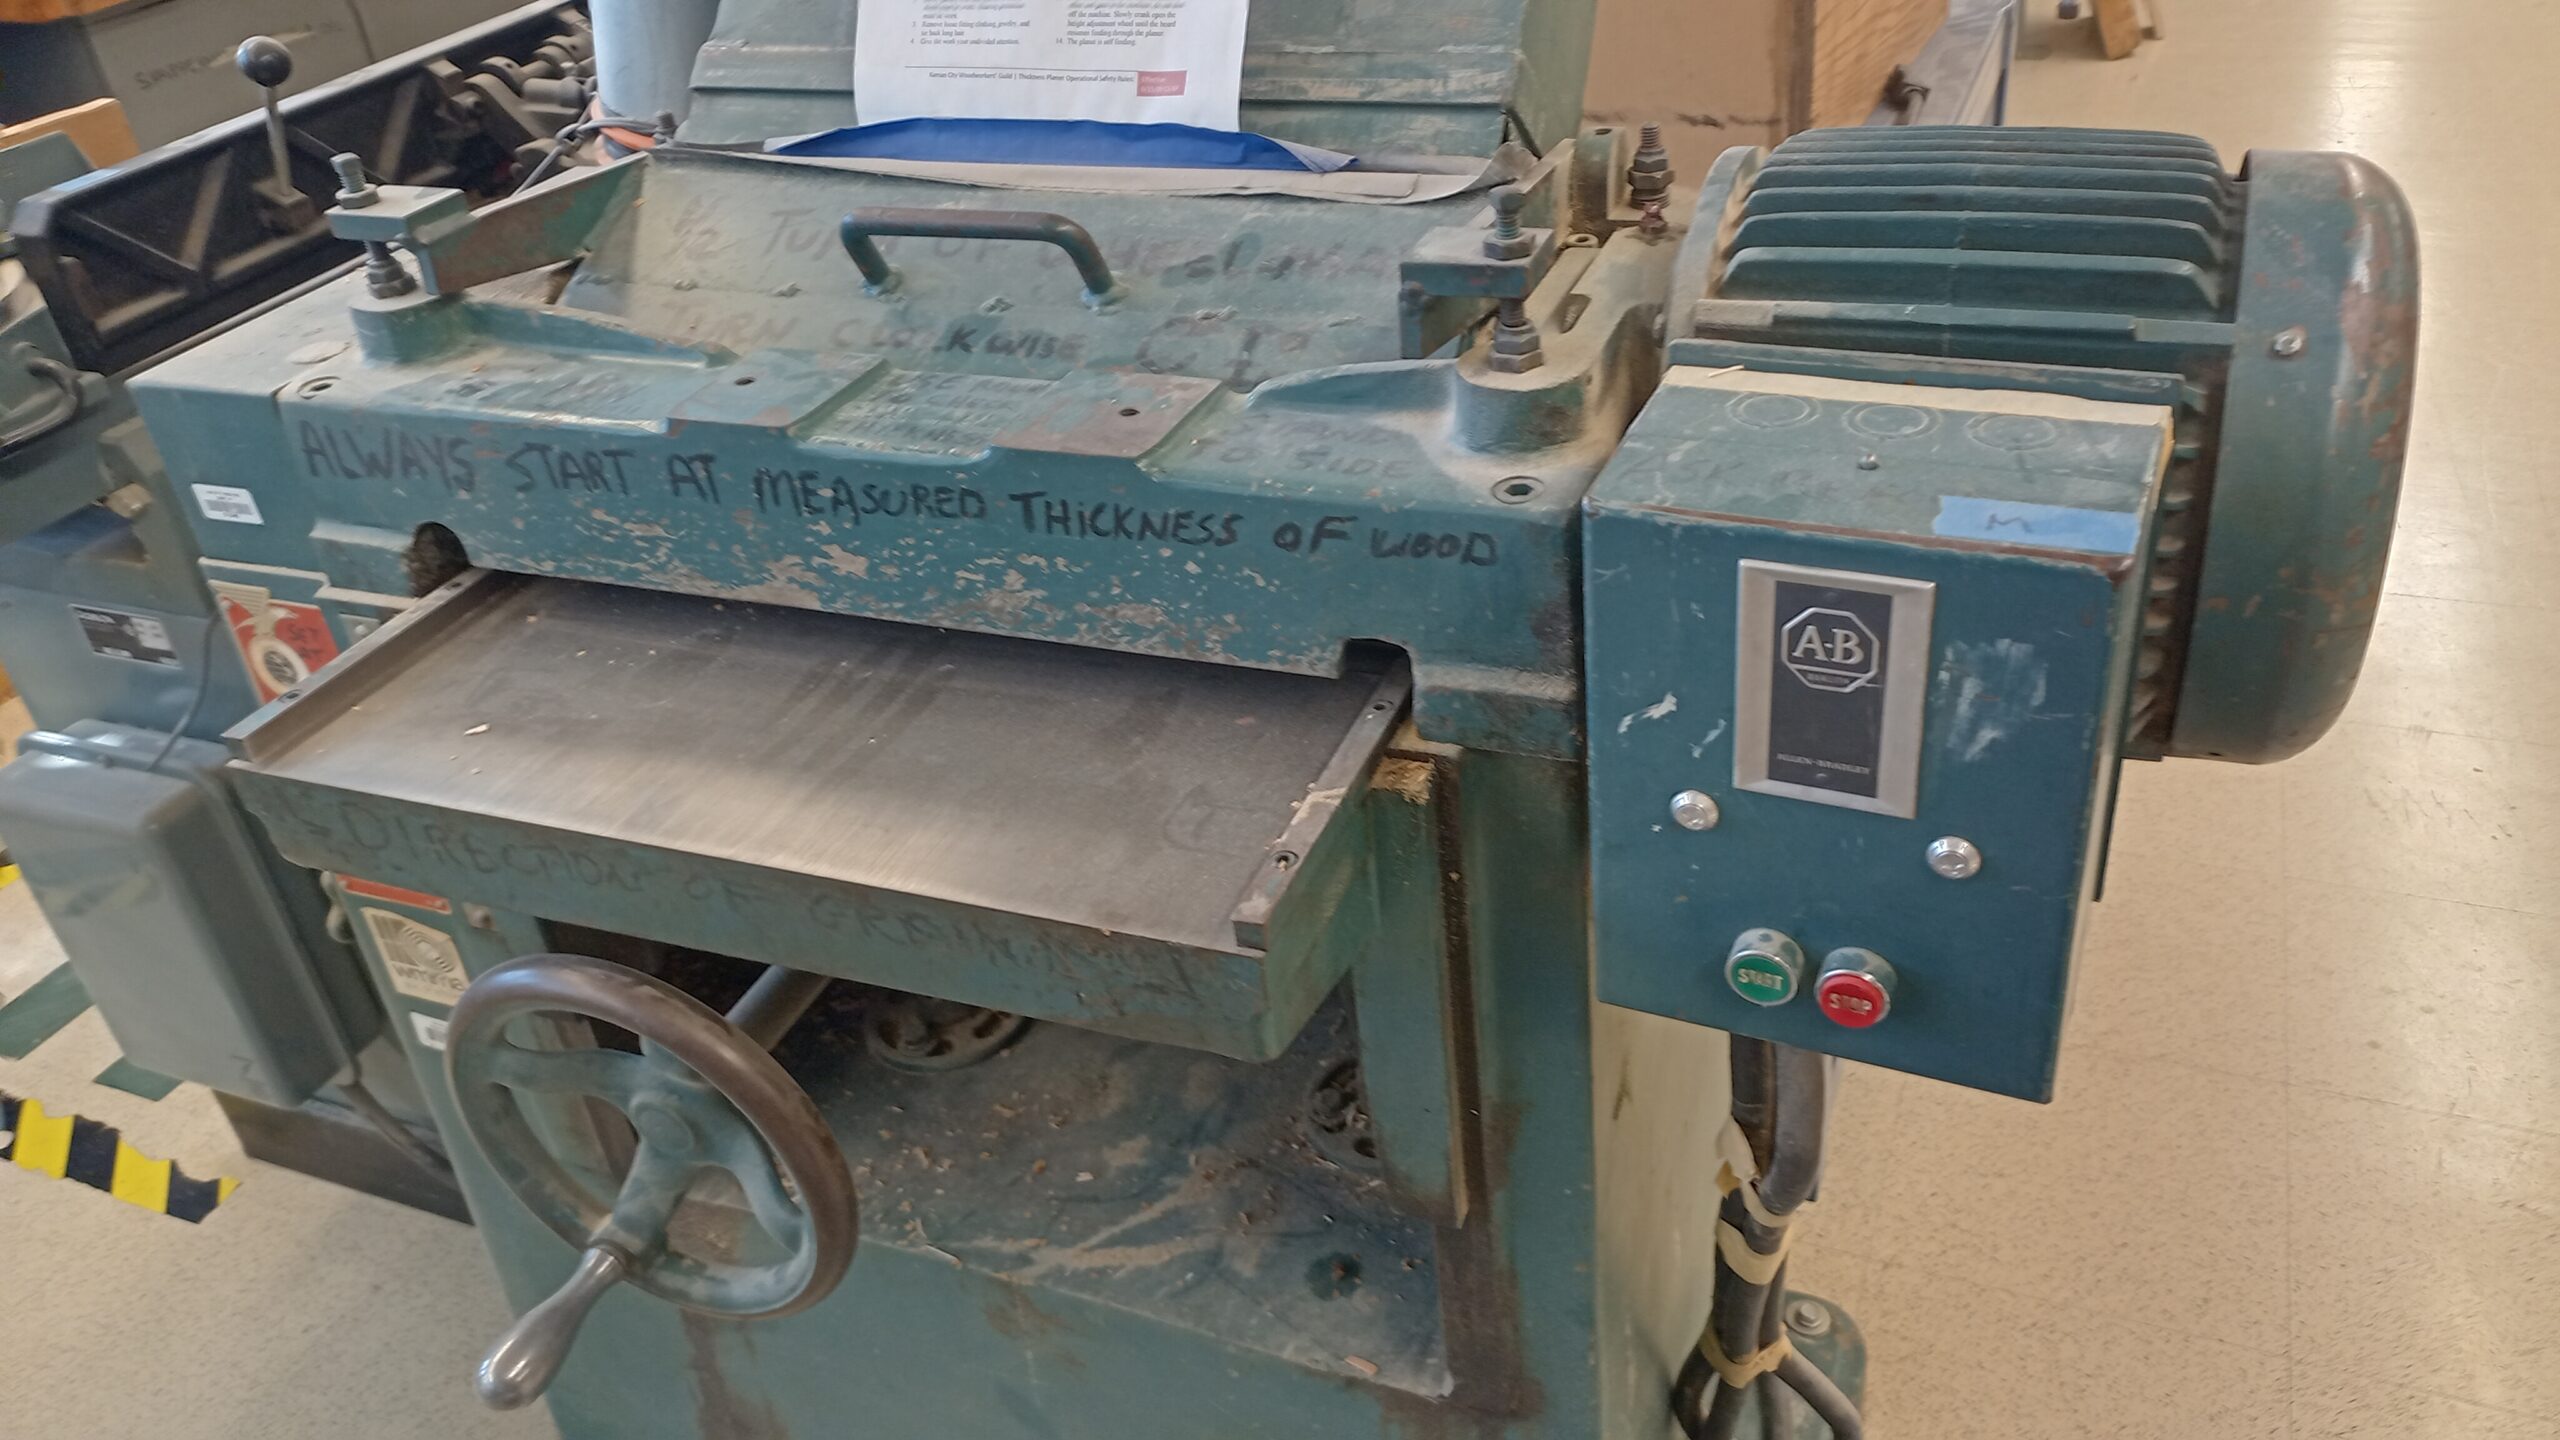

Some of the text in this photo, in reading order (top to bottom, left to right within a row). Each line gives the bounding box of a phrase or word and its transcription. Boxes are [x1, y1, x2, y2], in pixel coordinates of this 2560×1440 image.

[301, 418, 476, 494] ALWAYS
[505, 442, 635, 495] START
[667, 453, 719, 503] AT
[754, 466, 988, 526] MEASURED
[1273, 515, 1358, 553] OF
[1371, 527, 1498, 567] WOOD
[1791, 624, 1865, 665] A-B
[1738, 967, 1785, 991] START
[1828, 992, 1874, 1016] STOP
